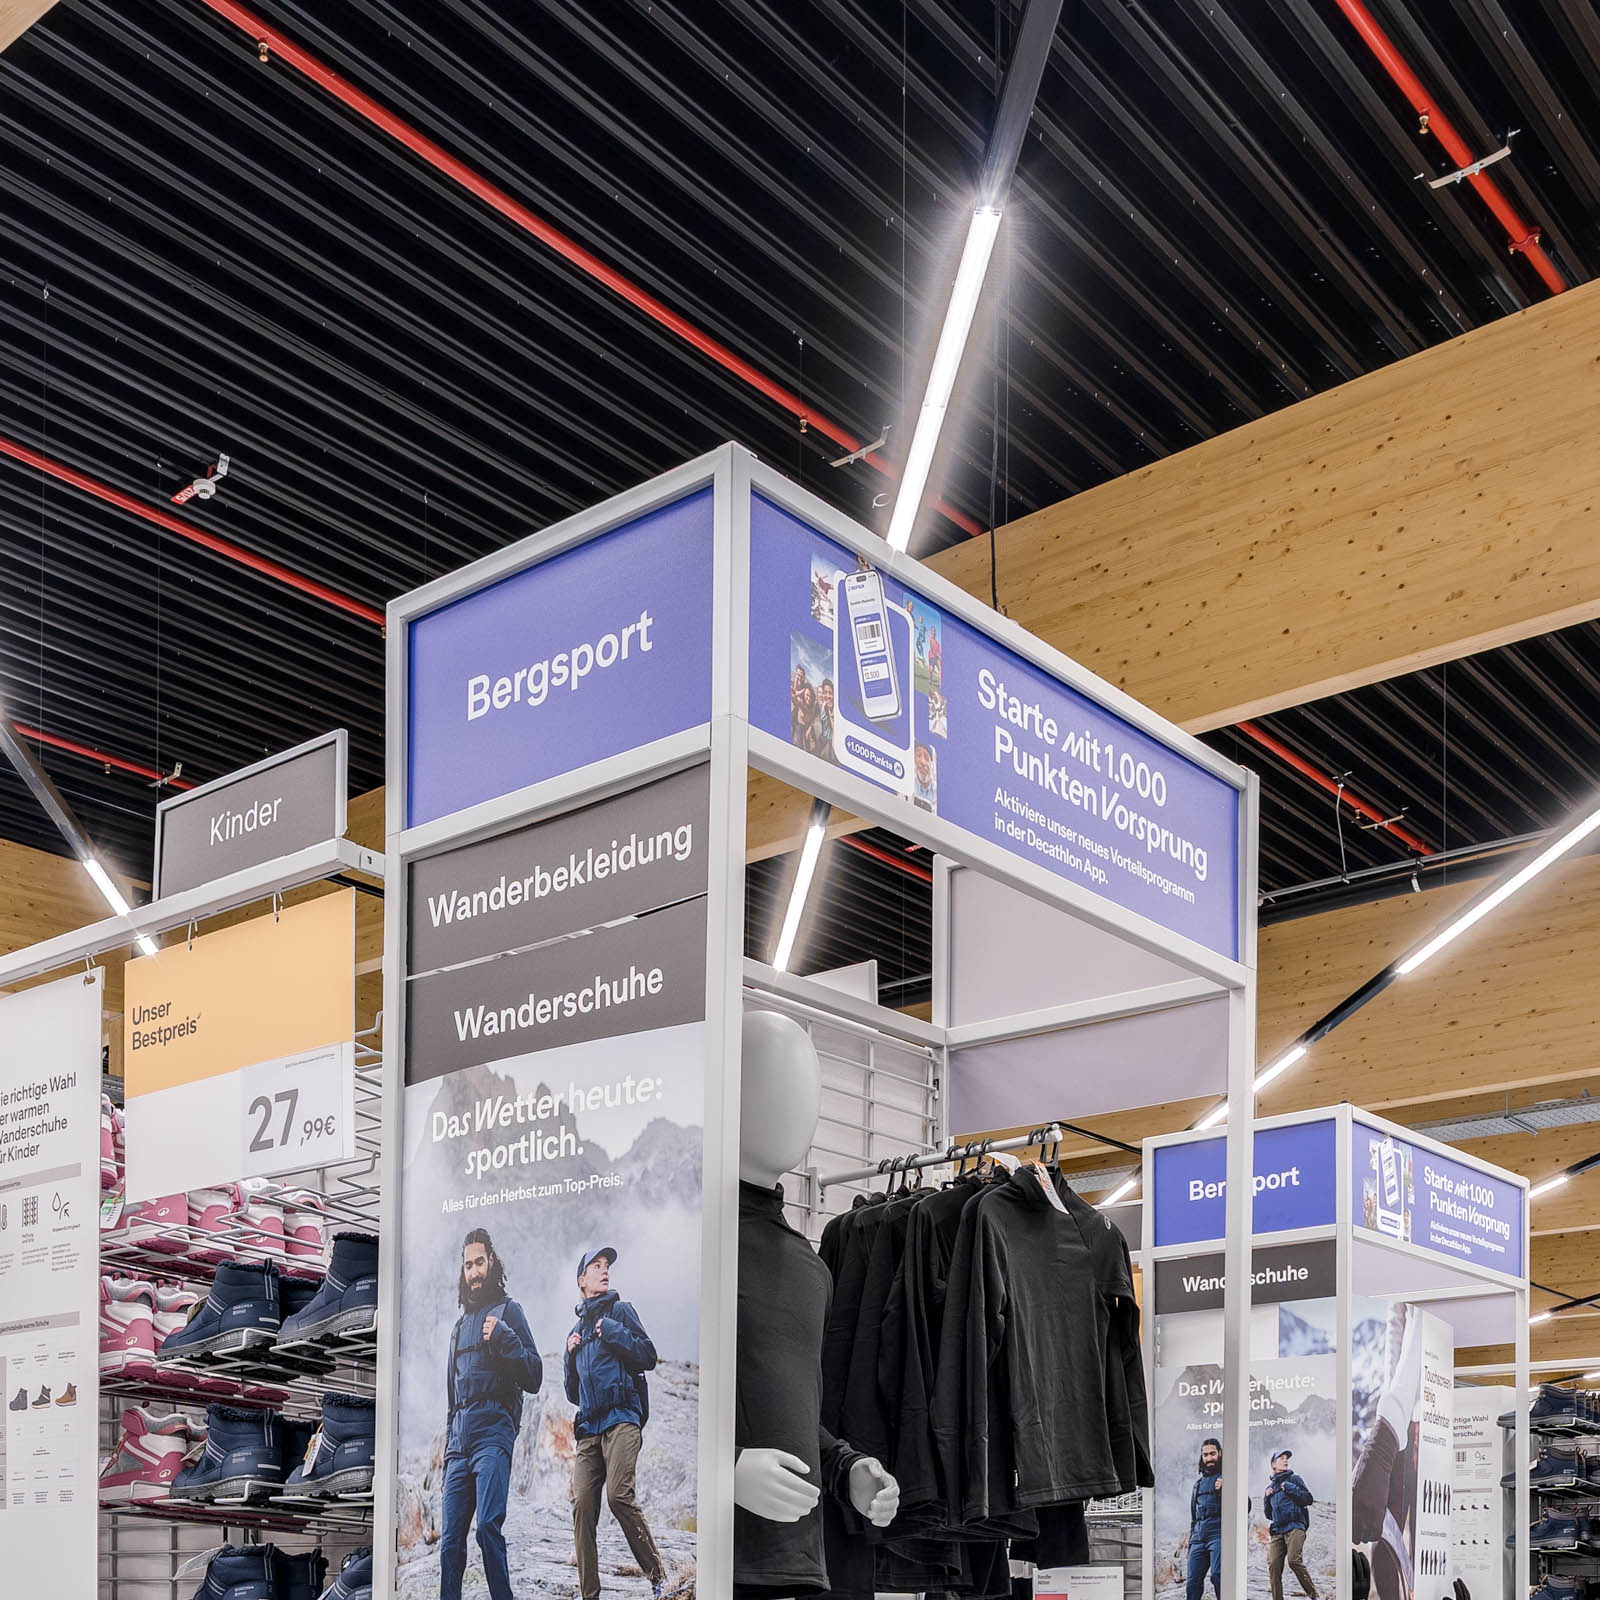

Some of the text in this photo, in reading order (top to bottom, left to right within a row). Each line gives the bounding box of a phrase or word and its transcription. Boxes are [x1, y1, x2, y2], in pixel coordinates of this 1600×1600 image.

[467, 610, 653, 721] Bergsport
[870, 751, 894, 771] Punkte
[977, 669, 1167, 807] Starte mit 1.000
[210, 797, 282, 846] Kinder
[995, 725, 1207, 882] Punkten Vorsprung
[995, 787, 1195, 904] Aktiviere unser neues Vorteilsprogramm
[995, 813, 1109, 885] in der Decathlon App.
[428, 824, 692, 928] Wanderbekleidung
[131, 1000, 172, 1026] Unser
[454, 965, 664, 1042] Wanderschuhe
[10, 1081, 48, 1103] richtige
[49, 1072, 77, 1093] Wahl
[10, 1101, 50, 1123] warmen
[432, 1073, 663, 1143] Das Wetter heute:
[8, 1142, 40, 1162] Kinder
[465, 1125, 584, 1180] sportlich.
[441, 1173, 624, 1214] Alles für den Herbst zum Top-Preis.
[1189, 1166, 1300, 1201] Berport
[1424, 1166, 1494, 1209] Starte mit 1.000
[1430, 1191, 1510, 1241] Punkten Vorsprung
[1182, 1265, 1309, 1293] Wanschuhe
[1178, 1382, 1207, 1397] Das
[1265, 1375, 1315, 1391] heute:
